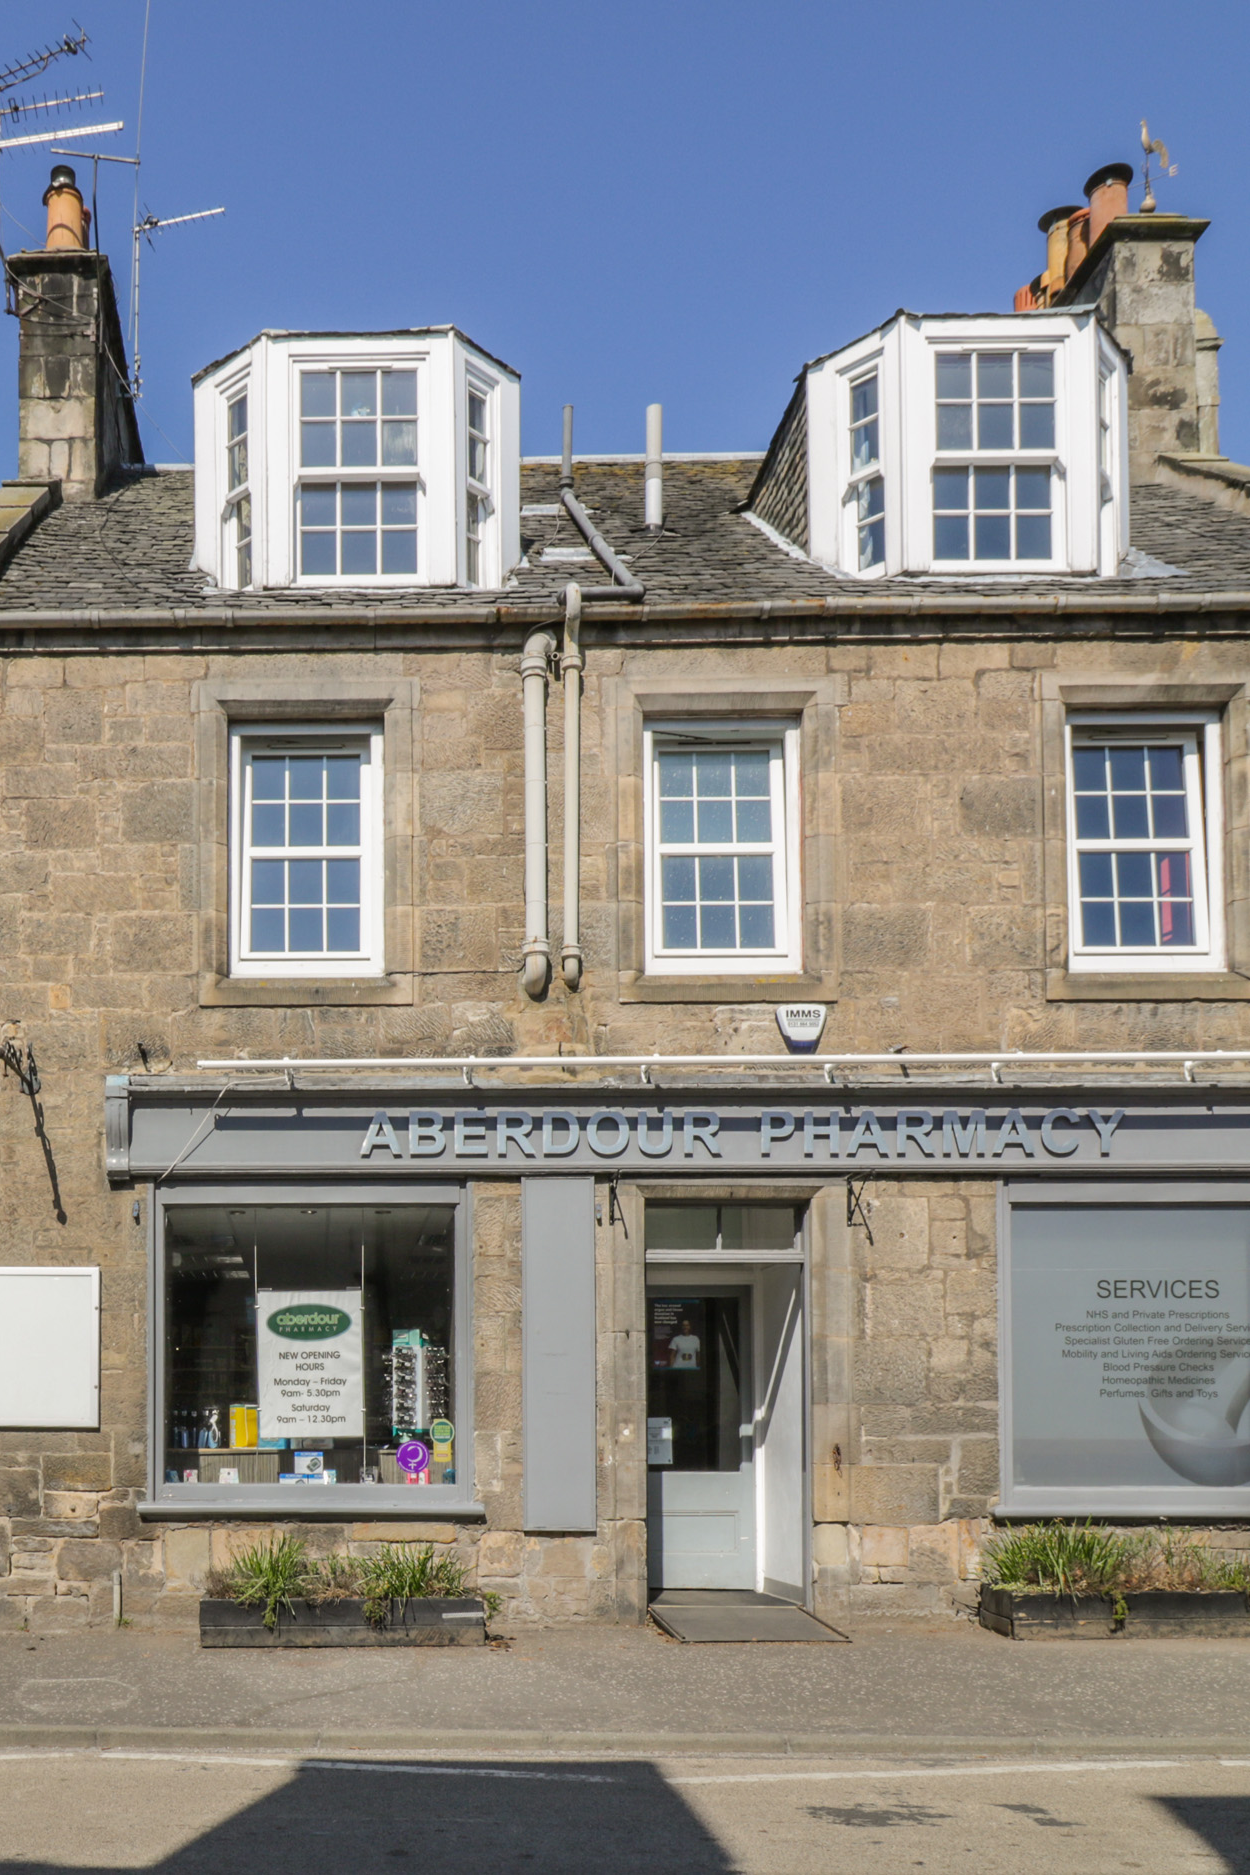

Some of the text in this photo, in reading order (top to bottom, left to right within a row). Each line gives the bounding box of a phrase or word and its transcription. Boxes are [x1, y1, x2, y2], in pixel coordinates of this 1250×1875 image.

[786, 1010, 821, 1018] IMMS
[360, 1108, 1126, 1156] ABERDOUR PHARMACY
[1096, 1279, 1220, 1299] SERVICES
[276, 1312, 340, 1326] aberdour
[1086, 1310, 1230, 1321] NHS and Private Prescriptions
[1055, 1323, 1111, 1333] Prescription
[1114, 1323, 1161, 1332] Collection
[1164, 1323, 1181, 1332] and
[1184, 1323, 1223, 1334] Delivery
[1064, 1336, 1110, 1347] Specialist
[1113, 1336, 1144, 1345] Gluten
[1147, 1336, 1169, 1345] Free
[1172, 1336, 1214, 1347] Ordering
[278, 1351, 341, 1359] NEW OPENING
[1062, 1350, 1098, 1360] Mobility
[1101, 1350, 1118, 1359] and
[1121, 1350, 1149, 1360] Living
[1152, 1350, 1172, 1359] Aids
[1175, 1350, 1217, 1360] Ordering
[295, 1363, 325, 1371] HOURS
[1103, 1362, 1214, 1372] Blood Pressure Checks
[273, 1378, 311, 1386] Monday
[320, 1377, 347, 1386] Friday
[1102, 1376, 1216, 1386] Homeopathic Medicines
[306, 1389, 341, 1398] 5.30pm
[1099, 1389, 1219, 1399] Perfumes, Gifts and Toys
[291, 1403, 331, 1413] Saturday
[276, 1416, 297, 1424] 9am
[307, 1415, 346, 1424] 12.30pm
